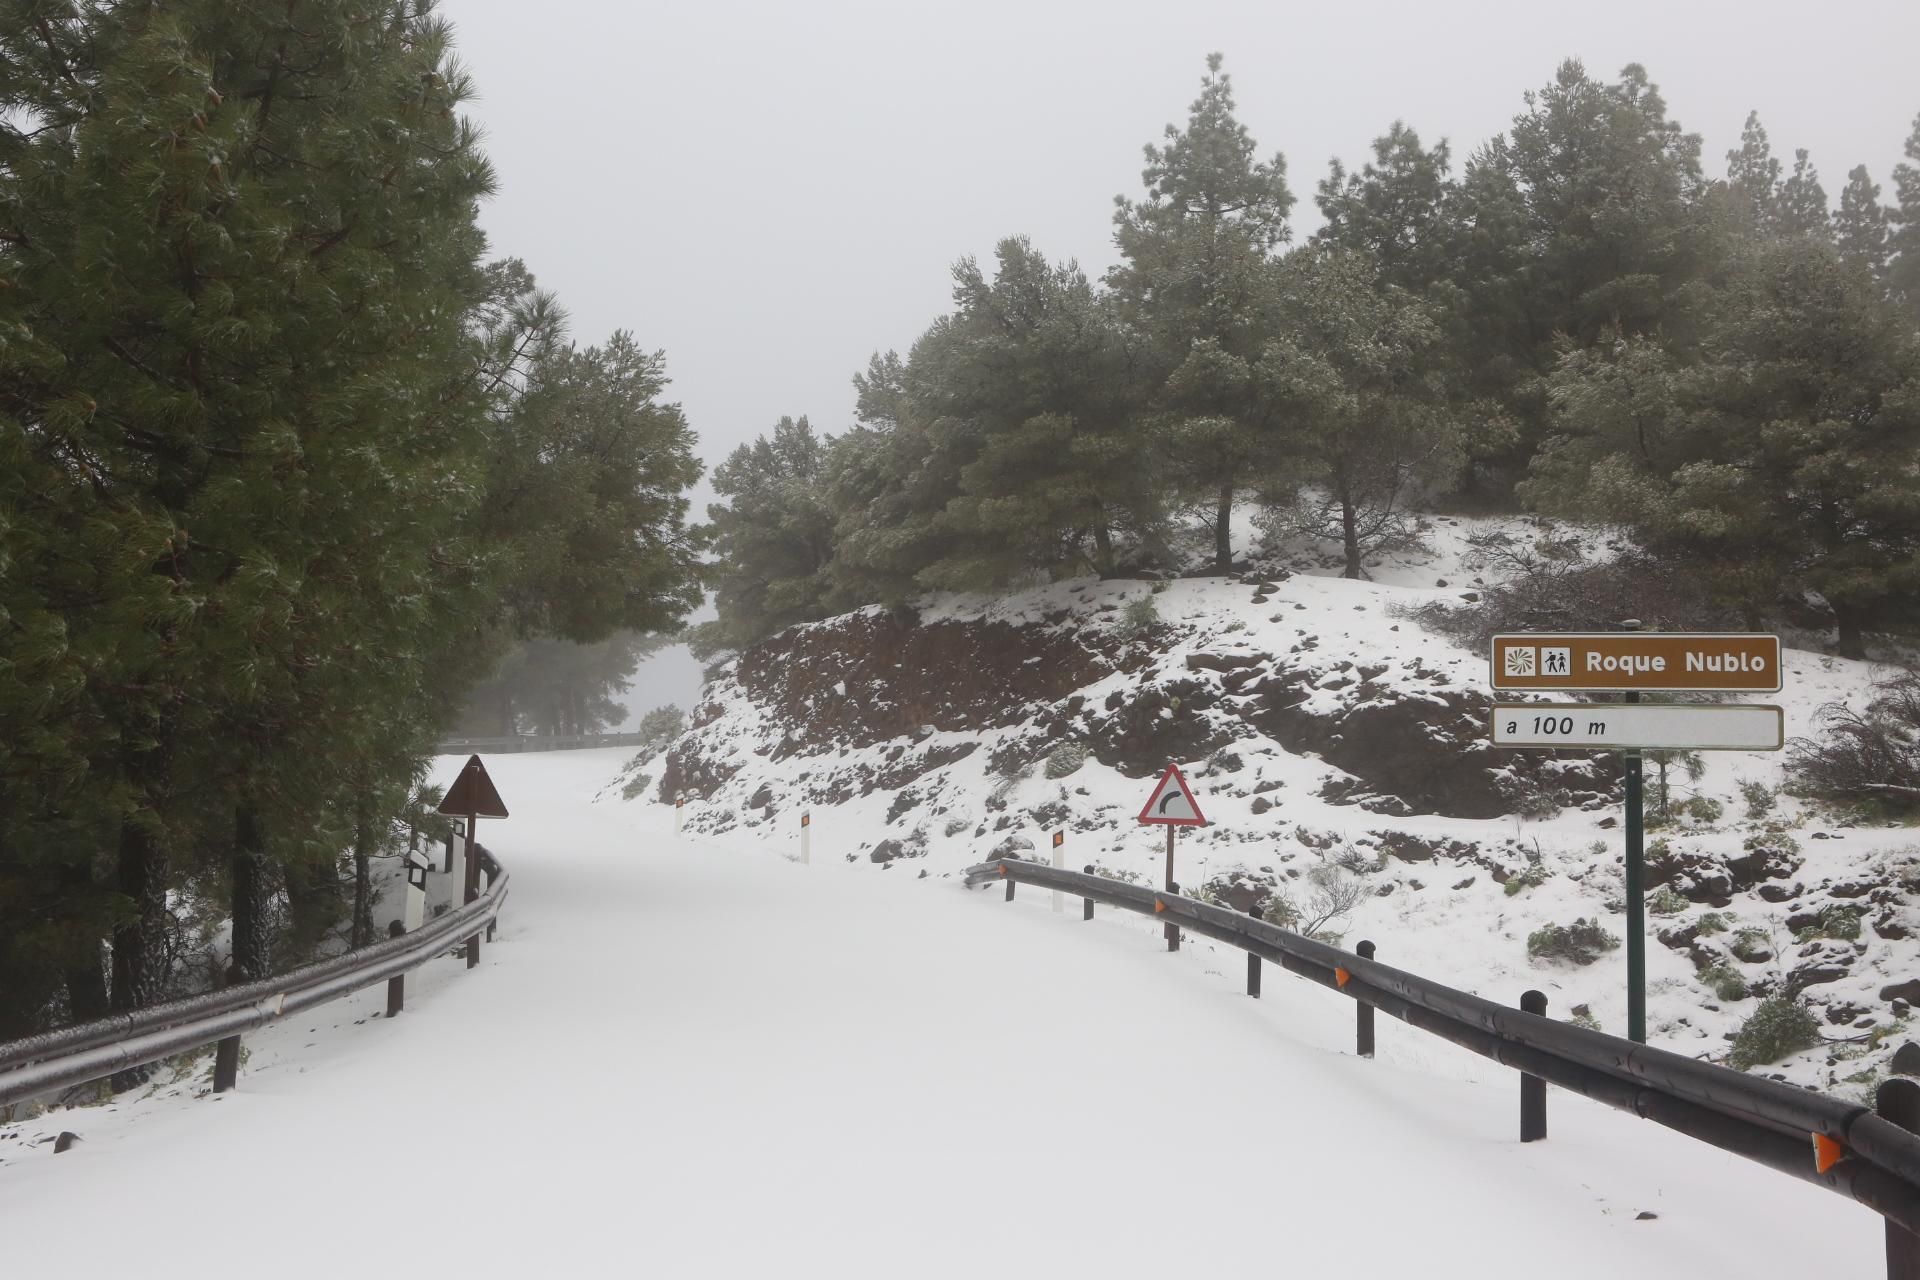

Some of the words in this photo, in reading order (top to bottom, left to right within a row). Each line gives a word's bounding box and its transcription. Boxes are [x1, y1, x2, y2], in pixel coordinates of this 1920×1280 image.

[1586, 651, 1666, 676] Roque
[1685, 651, 1766, 673] Nublo
[1506, 720, 1518, 734] a
[1533, 716, 1574, 735] 100
[1588, 720, 1606, 735] m
